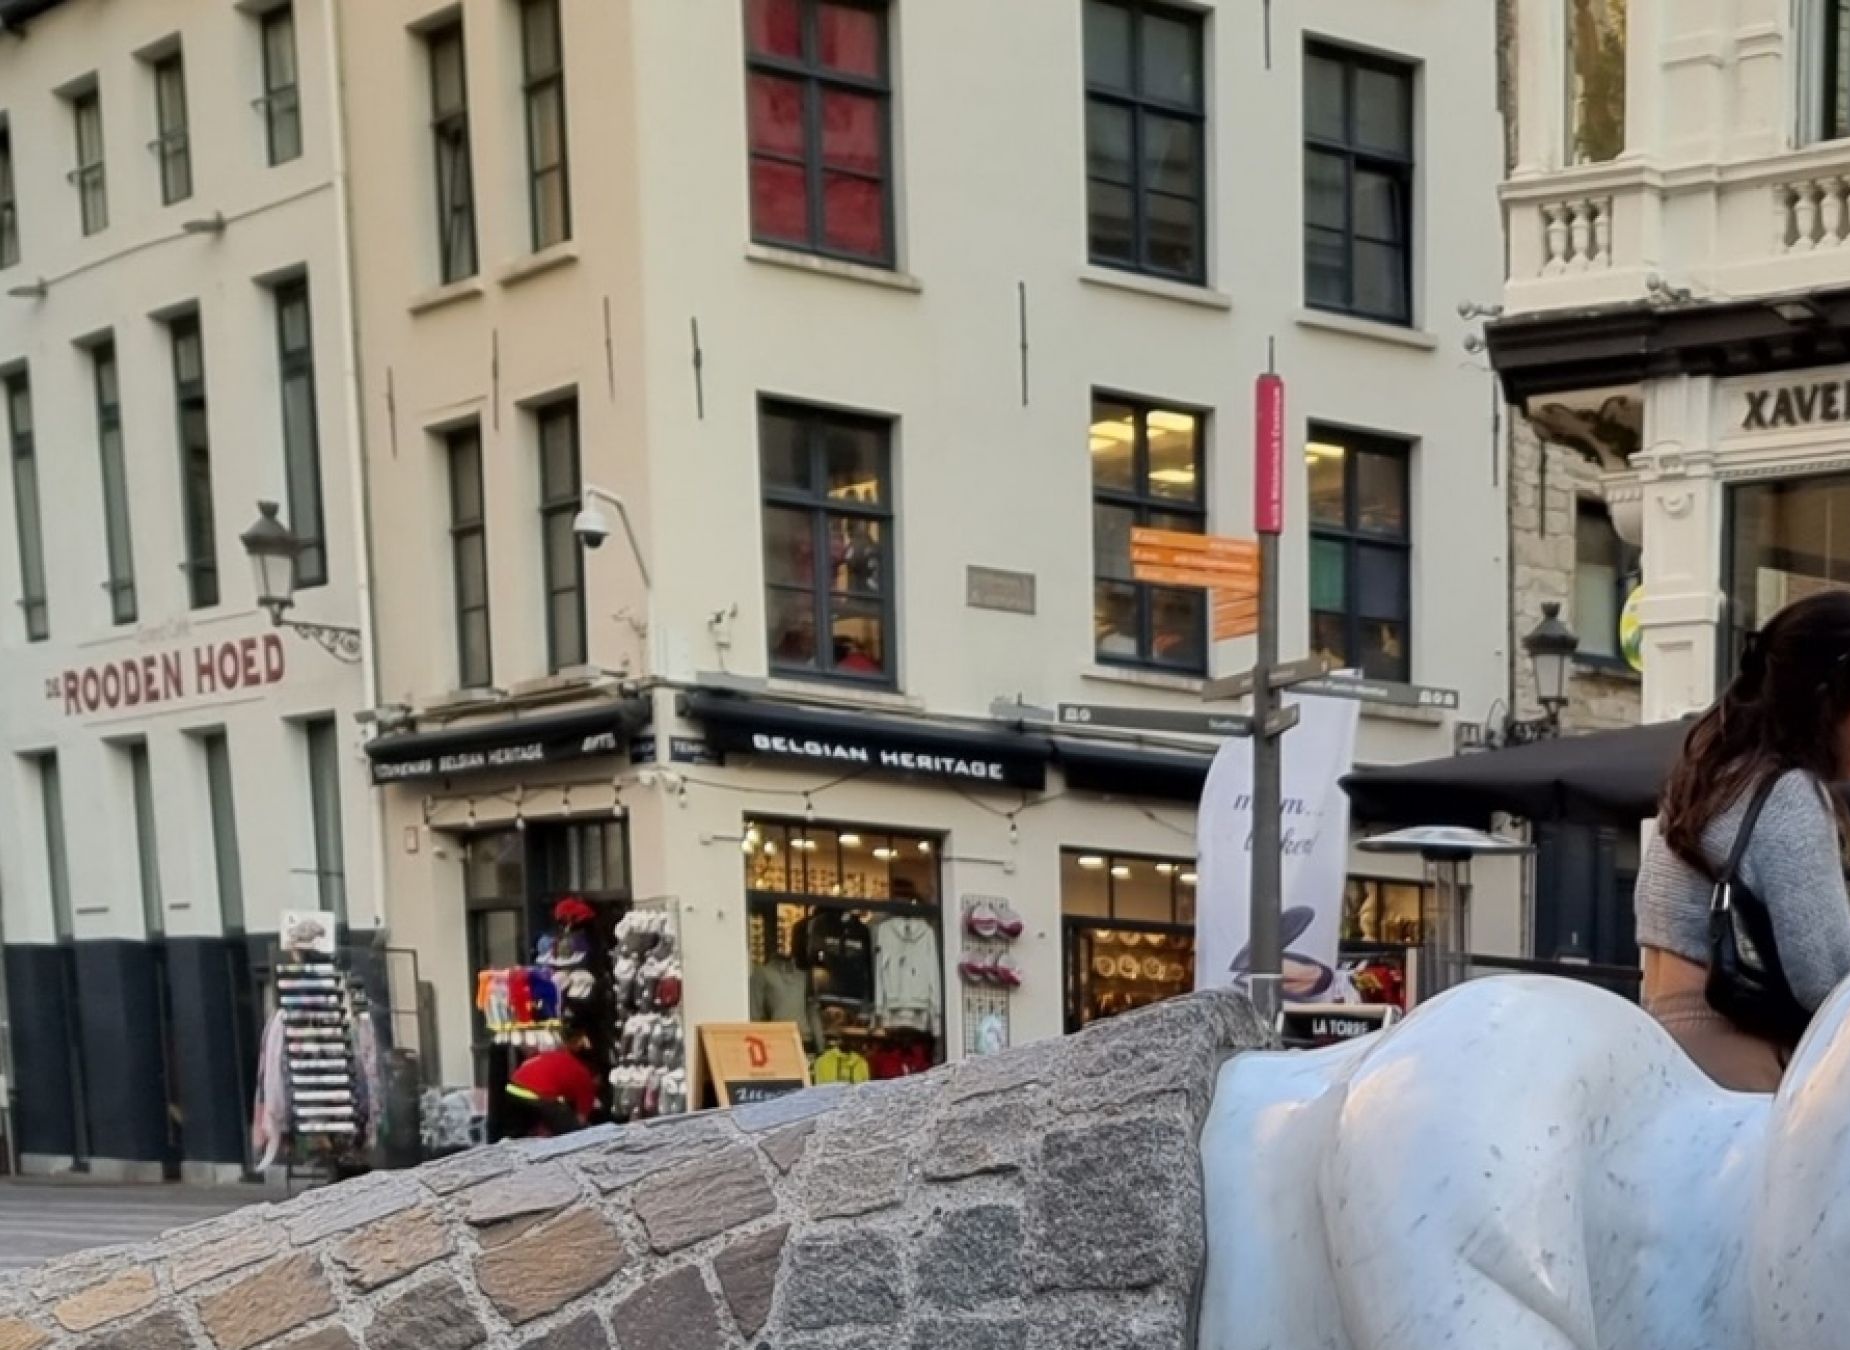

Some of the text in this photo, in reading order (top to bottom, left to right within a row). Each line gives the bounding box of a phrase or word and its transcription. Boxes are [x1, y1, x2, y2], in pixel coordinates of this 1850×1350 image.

[63, 650, 183, 717] ROODEN
[194, 633, 286, 694] HOED
[439, 754, 484, 773] BELGIAN
[488, 743, 543, 765] HERITAGE
[752, 733, 869, 762] BELGIAN
[880, 749, 1004, 780] HERITAGE
